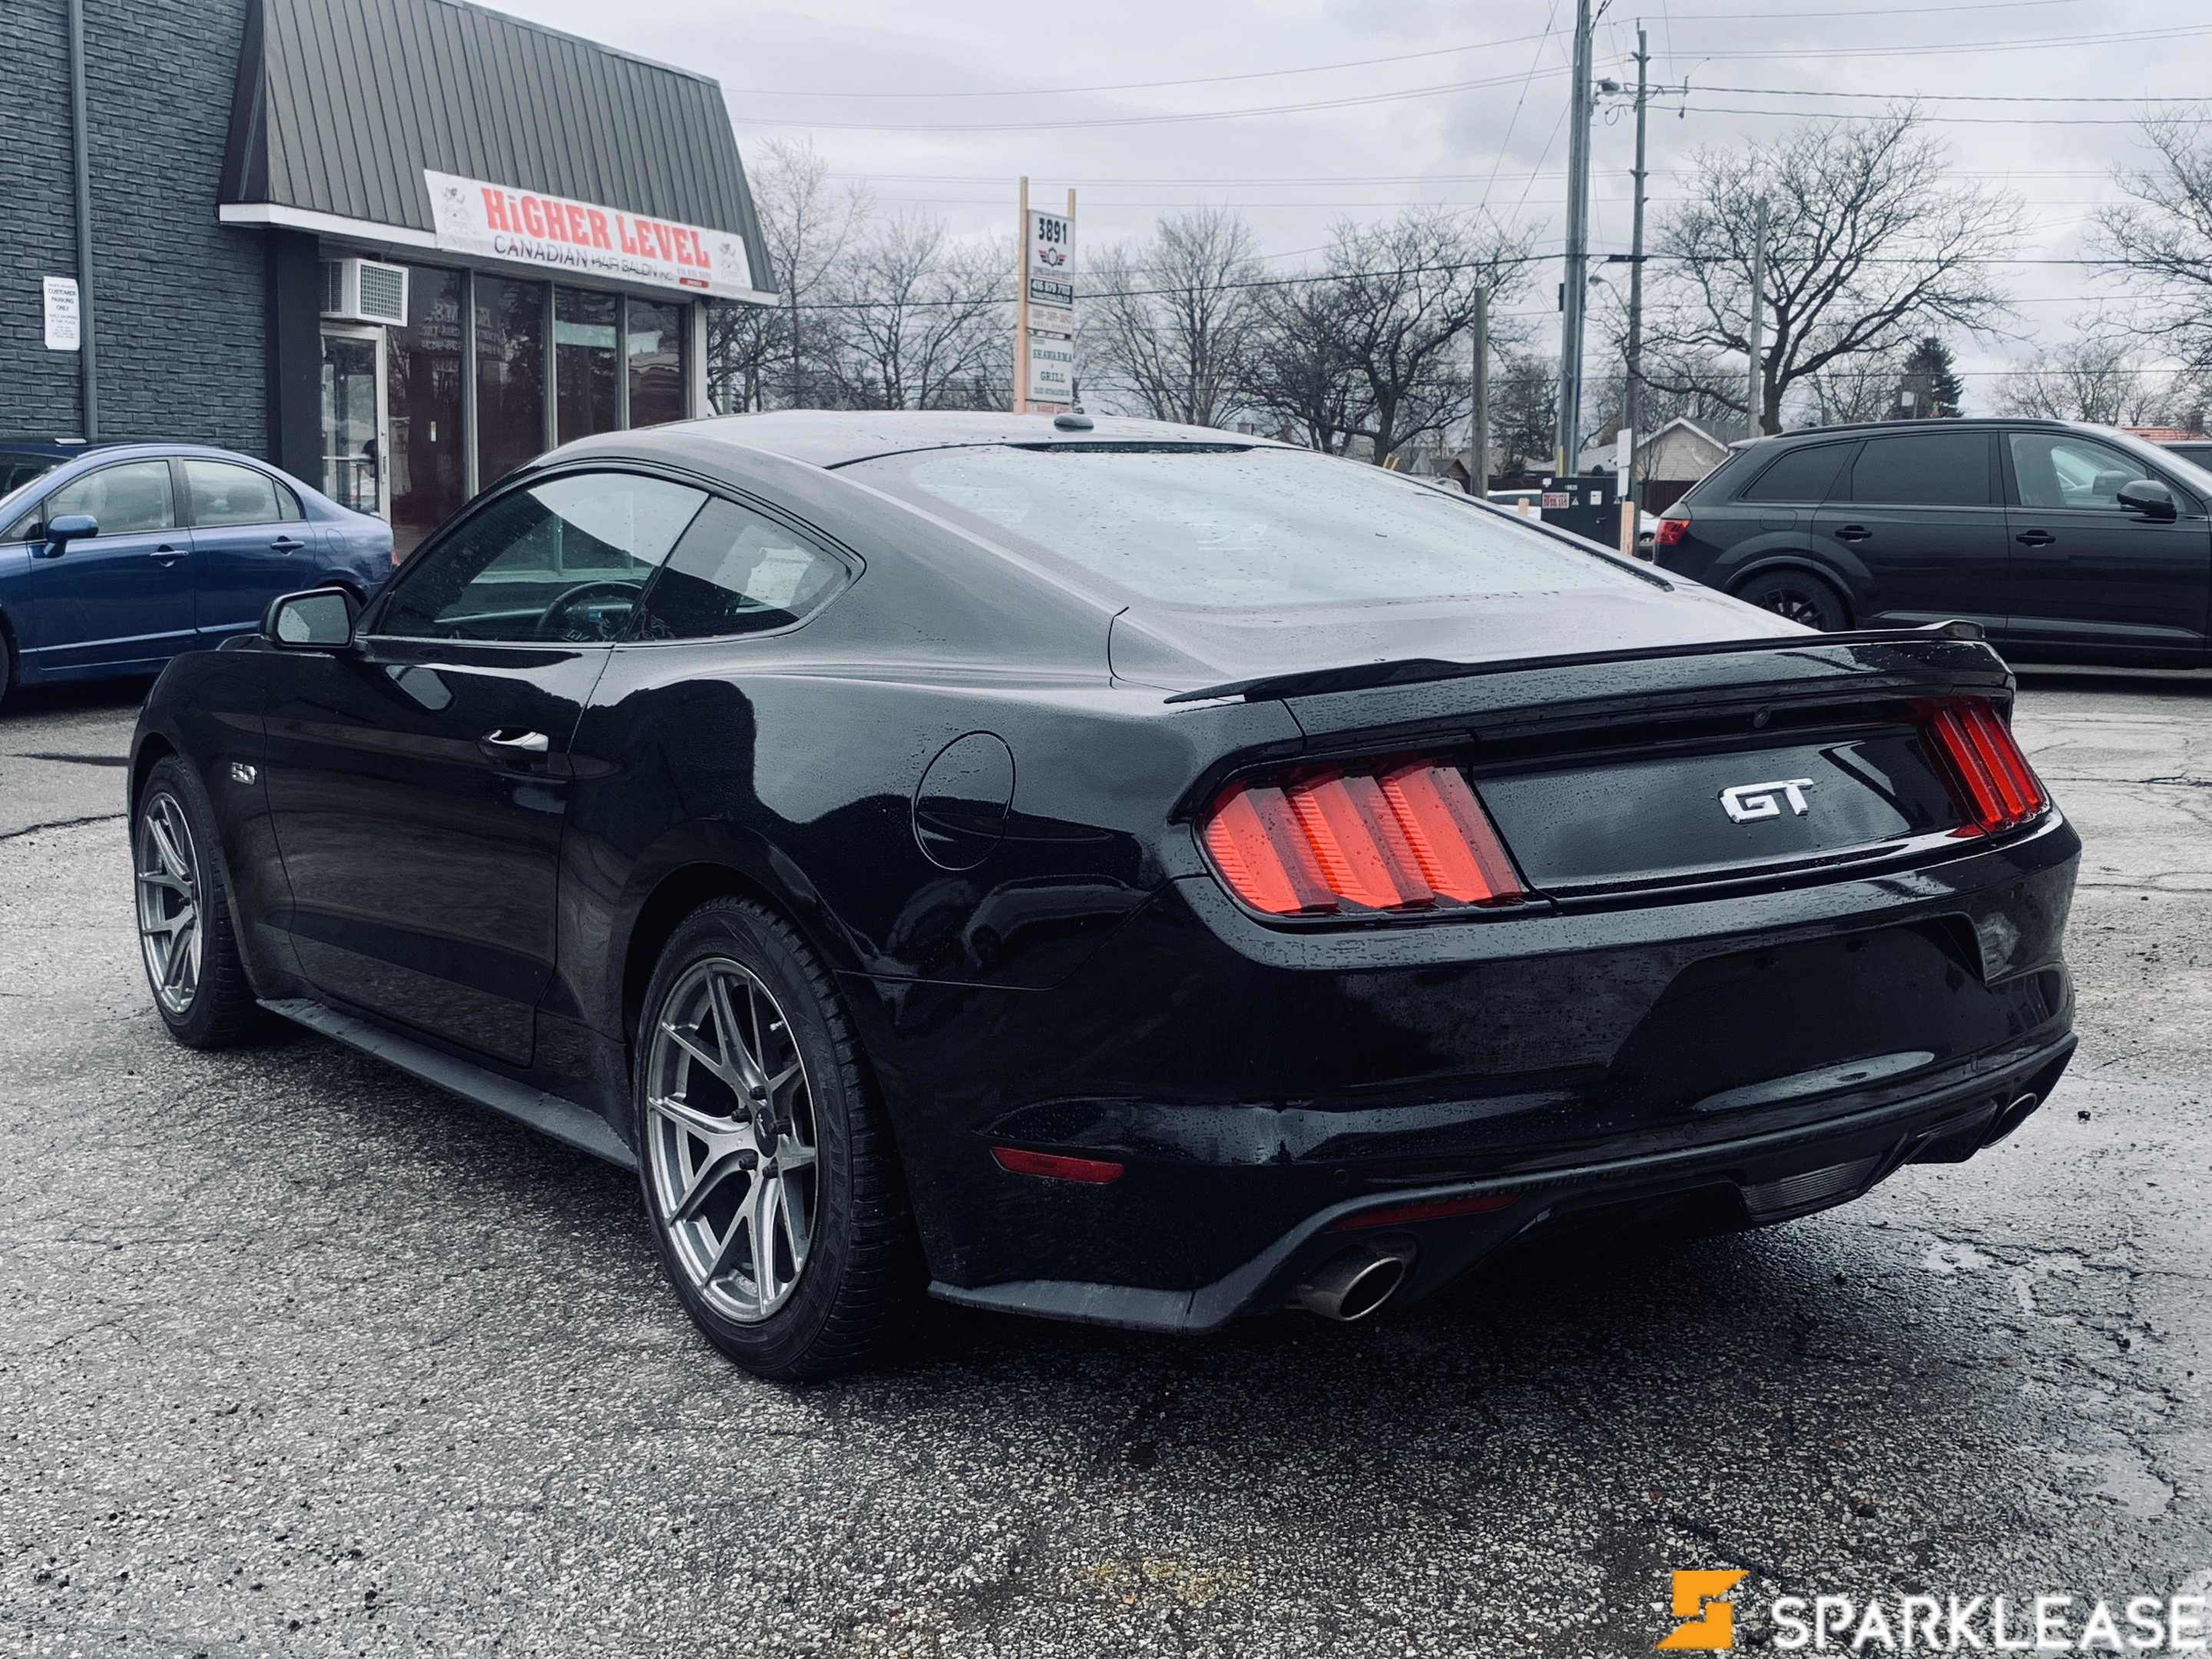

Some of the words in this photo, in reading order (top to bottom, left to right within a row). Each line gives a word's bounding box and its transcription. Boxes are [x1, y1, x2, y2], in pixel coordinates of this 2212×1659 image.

[616, 214, 711, 269] LEVEL
[1038, 217, 1067, 245] 3891
[495, 235, 590, 267] CANADIAN
[621, 259, 657, 277] SALON
[1041, 371, 1065, 383] GRILL
[1718, 778, 1814, 824] GT
